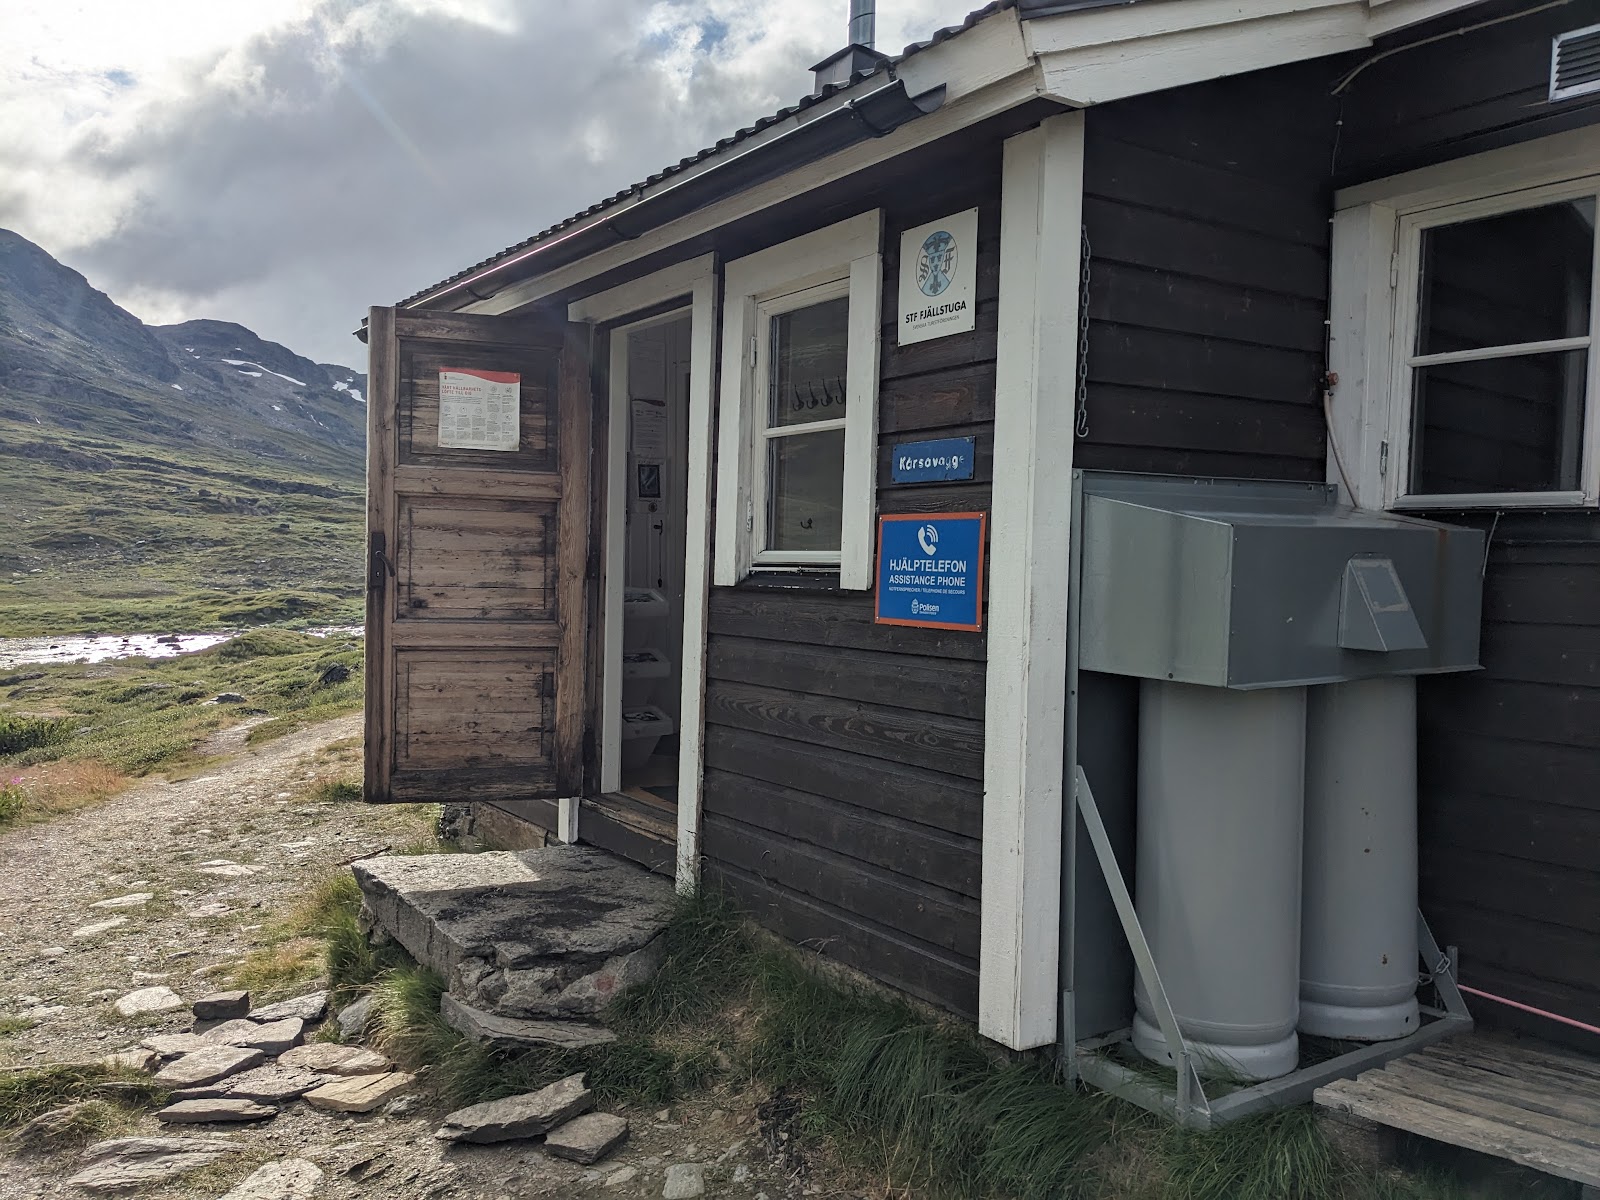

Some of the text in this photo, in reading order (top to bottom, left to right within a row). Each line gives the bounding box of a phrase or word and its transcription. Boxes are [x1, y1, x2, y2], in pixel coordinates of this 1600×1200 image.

[905, 300, 967, 324] STF FJÄLLSTUGA
[889, 557, 967, 573] HJÄLPTELEFON
[888, 574, 966, 587] ASSISTANCE PHONE
[919, 603, 940, 612] Polisen
